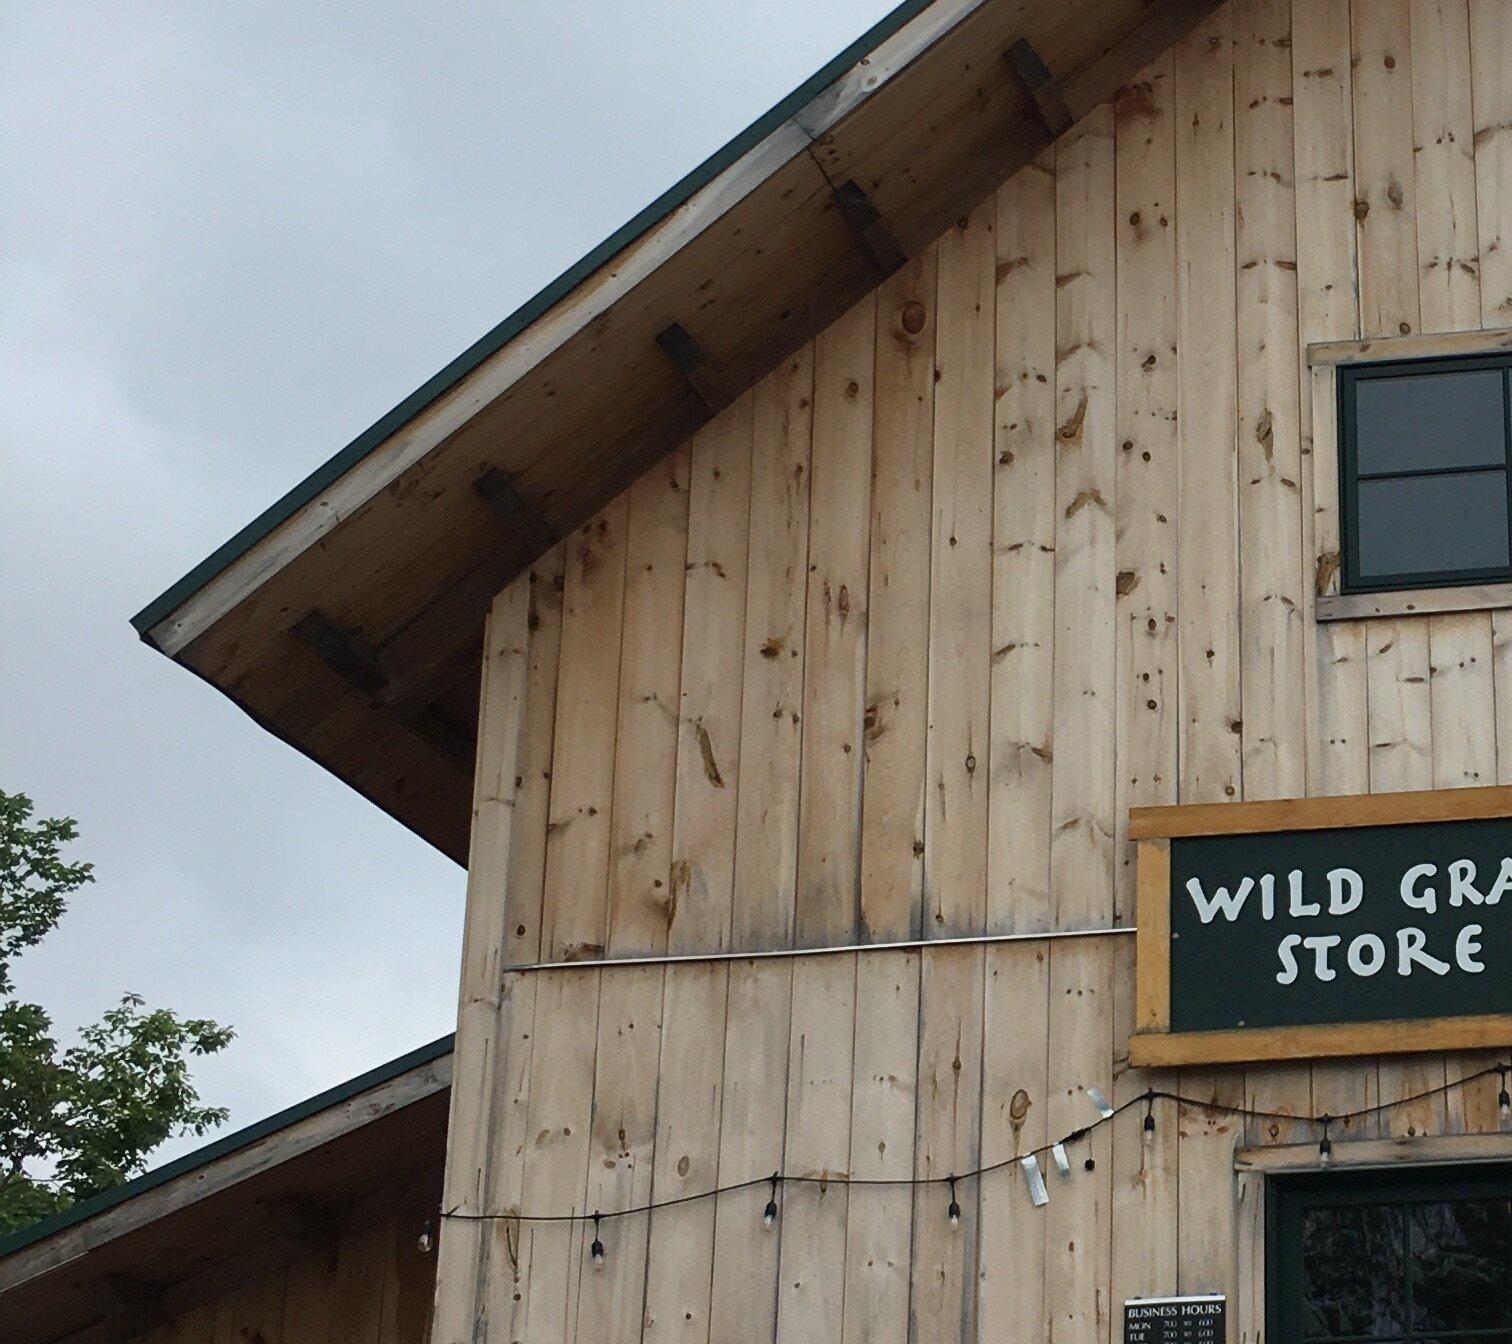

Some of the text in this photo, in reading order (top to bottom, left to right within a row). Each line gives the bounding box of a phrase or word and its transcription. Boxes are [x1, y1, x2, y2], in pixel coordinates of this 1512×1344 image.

[1185, 867, 1365, 924] WILD
[1276, 924, 1485, 985] STORE
[1128, 1304, 1222, 1319] BUSINESS HOURS
[1128, 1321, 1151, 1330] MON
